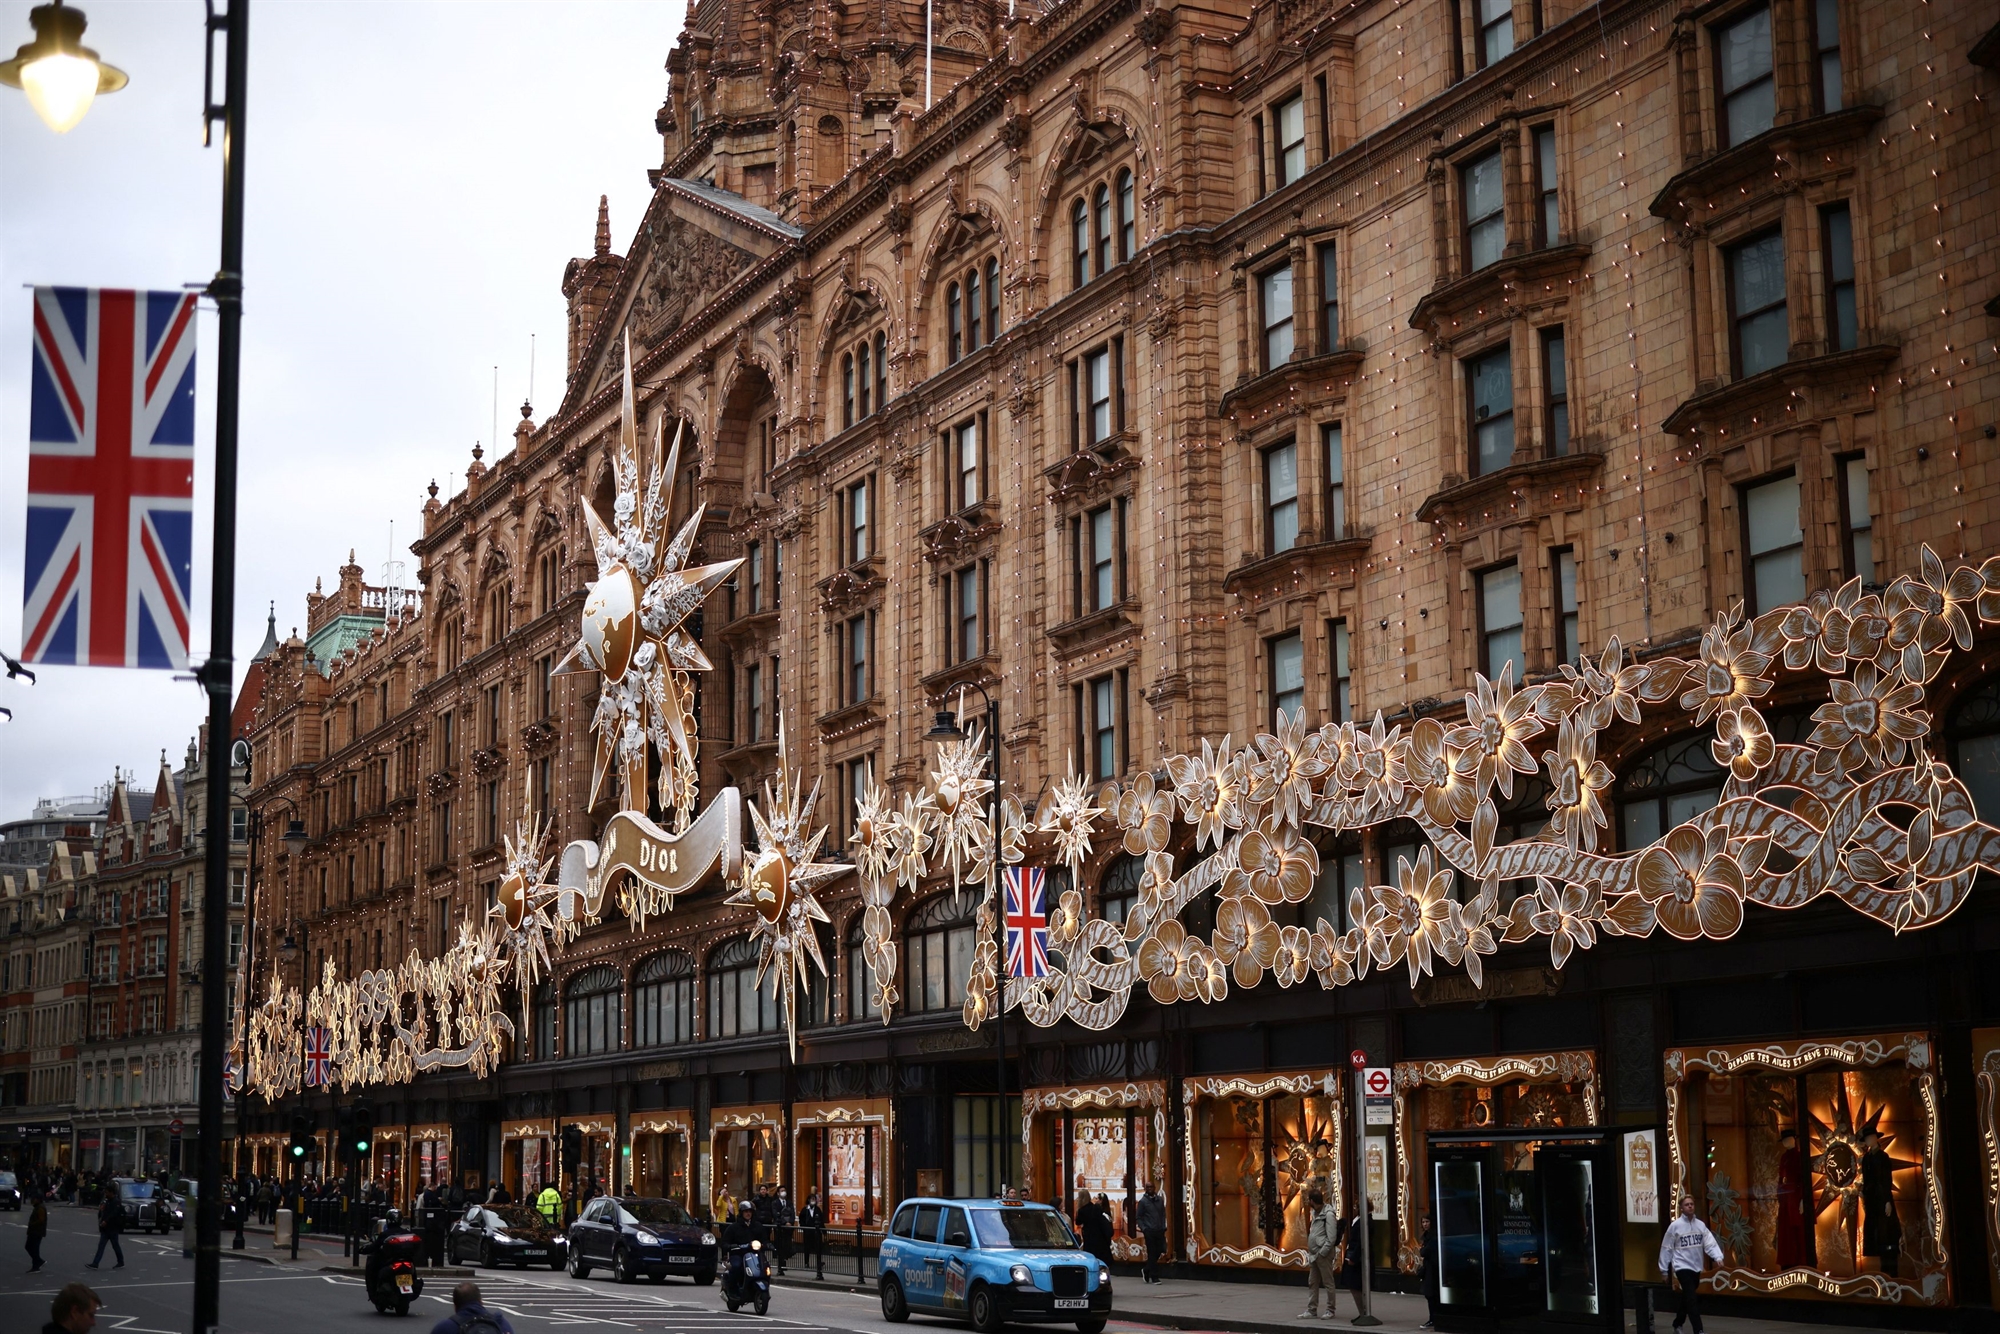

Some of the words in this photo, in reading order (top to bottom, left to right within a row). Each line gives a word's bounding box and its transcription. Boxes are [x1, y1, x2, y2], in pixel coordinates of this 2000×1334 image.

[640, 838, 678, 873] DIOR
[1352, 1055, 1365, 1064] KA
[1757, 1053, 1769, 1063] TES
[1772, 1058, 1790, 1068] AILES
[1793, 1058, 1801, 1067] ET
[1824, 1047, 1854, 1063] D'INFINI
[1368, 1165, 1381, 1173] DIOR
[1633, 1160, 1649, 1169] DIOR
[1670, 1183, 1678, 1221] RIQUE
[1514, 1228, 1531, 1236] CHELSEA
[880, 1245, 893, 1257] Need
[893, 1246, 898, 1257] it
[886, 1257, 901, 1268] now?
[905, 1264, 933, 1289] gopuff
[1767, 1272, 1807, 1290] CHRISTIAN
[1818, 1278, 1840, 1295] DIOR
